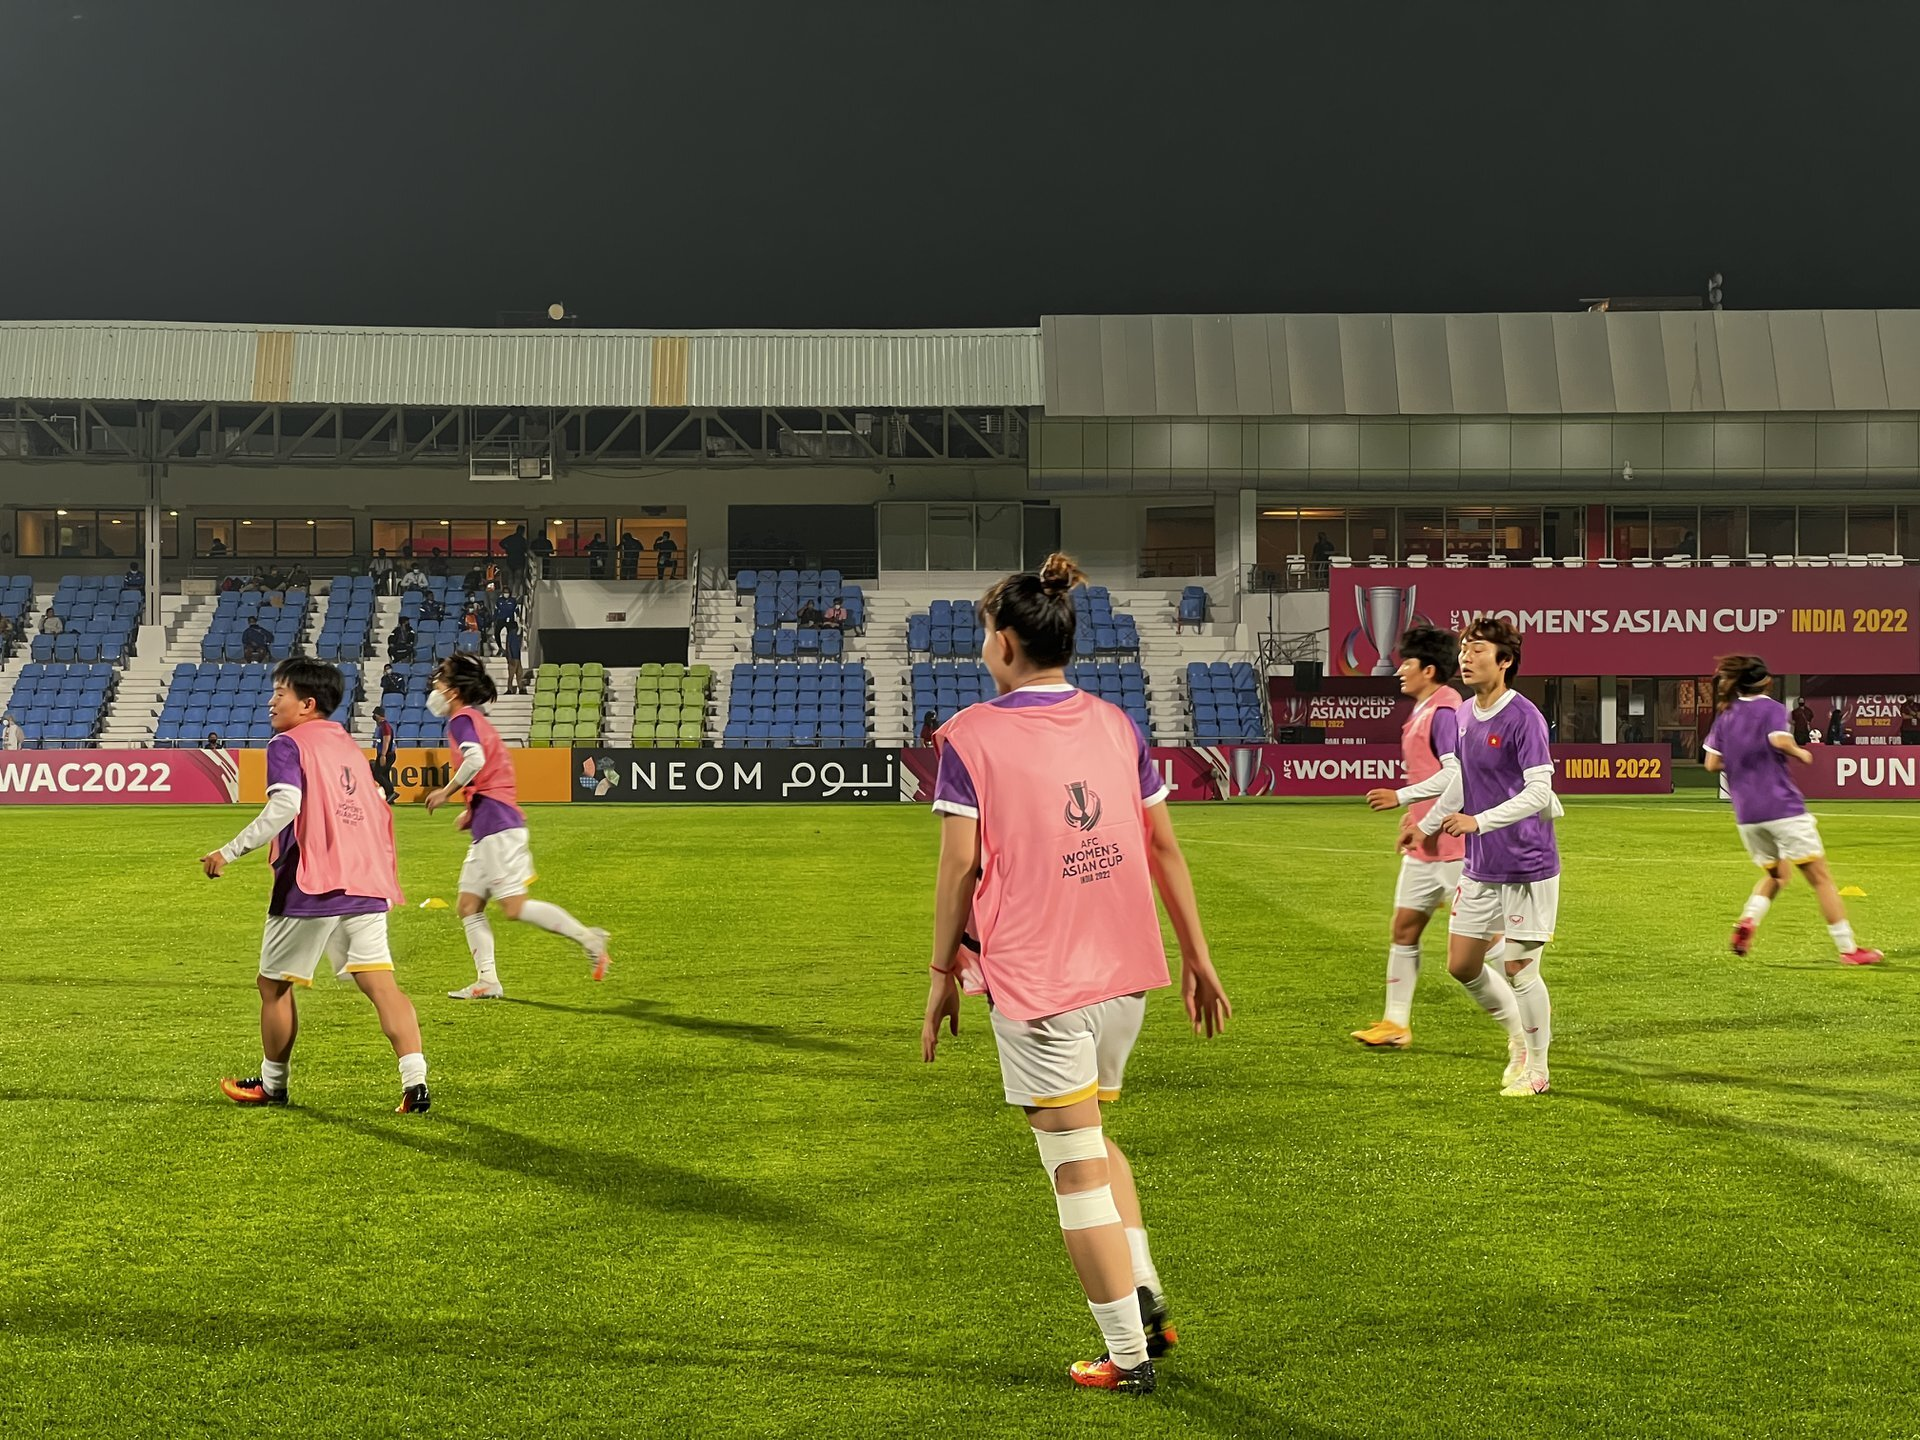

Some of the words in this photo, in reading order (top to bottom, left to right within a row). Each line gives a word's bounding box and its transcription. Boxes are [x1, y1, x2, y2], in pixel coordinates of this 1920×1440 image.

[1451, 610, 1459, 632] AFC
[1613, 609, 1706, 633] ASIAN
[1792, 609, 1846, 632] INDIA
[1853, 608, 1908, 632] 2022
[1311, 696, 1335, 706] AFC
[1339, 695, 1396, 706] WOMEN'S
[1856, 694, 1881, 704] AFC
[1311, 707, 1356, 719] ASIAN
[632, 762, 761, 791] NEOM
[782, 754, 893, 797] نيوم
[1283, 760, 1291, 779] AFC
[1565, 759, 1610, 779] INDIA
[1615, 759, 1661, 779] 2022
[1836, 757, 1916, 787] PUN
[1081, 837, 1099, 849] AFC
[1062, 843, 1120, 865] WOMEN'S
[1062, 860, 1098, 879] ASIAN
[1098, 854, 1124, 869] CUP
[1095, 869, 1111, 881] 2022
